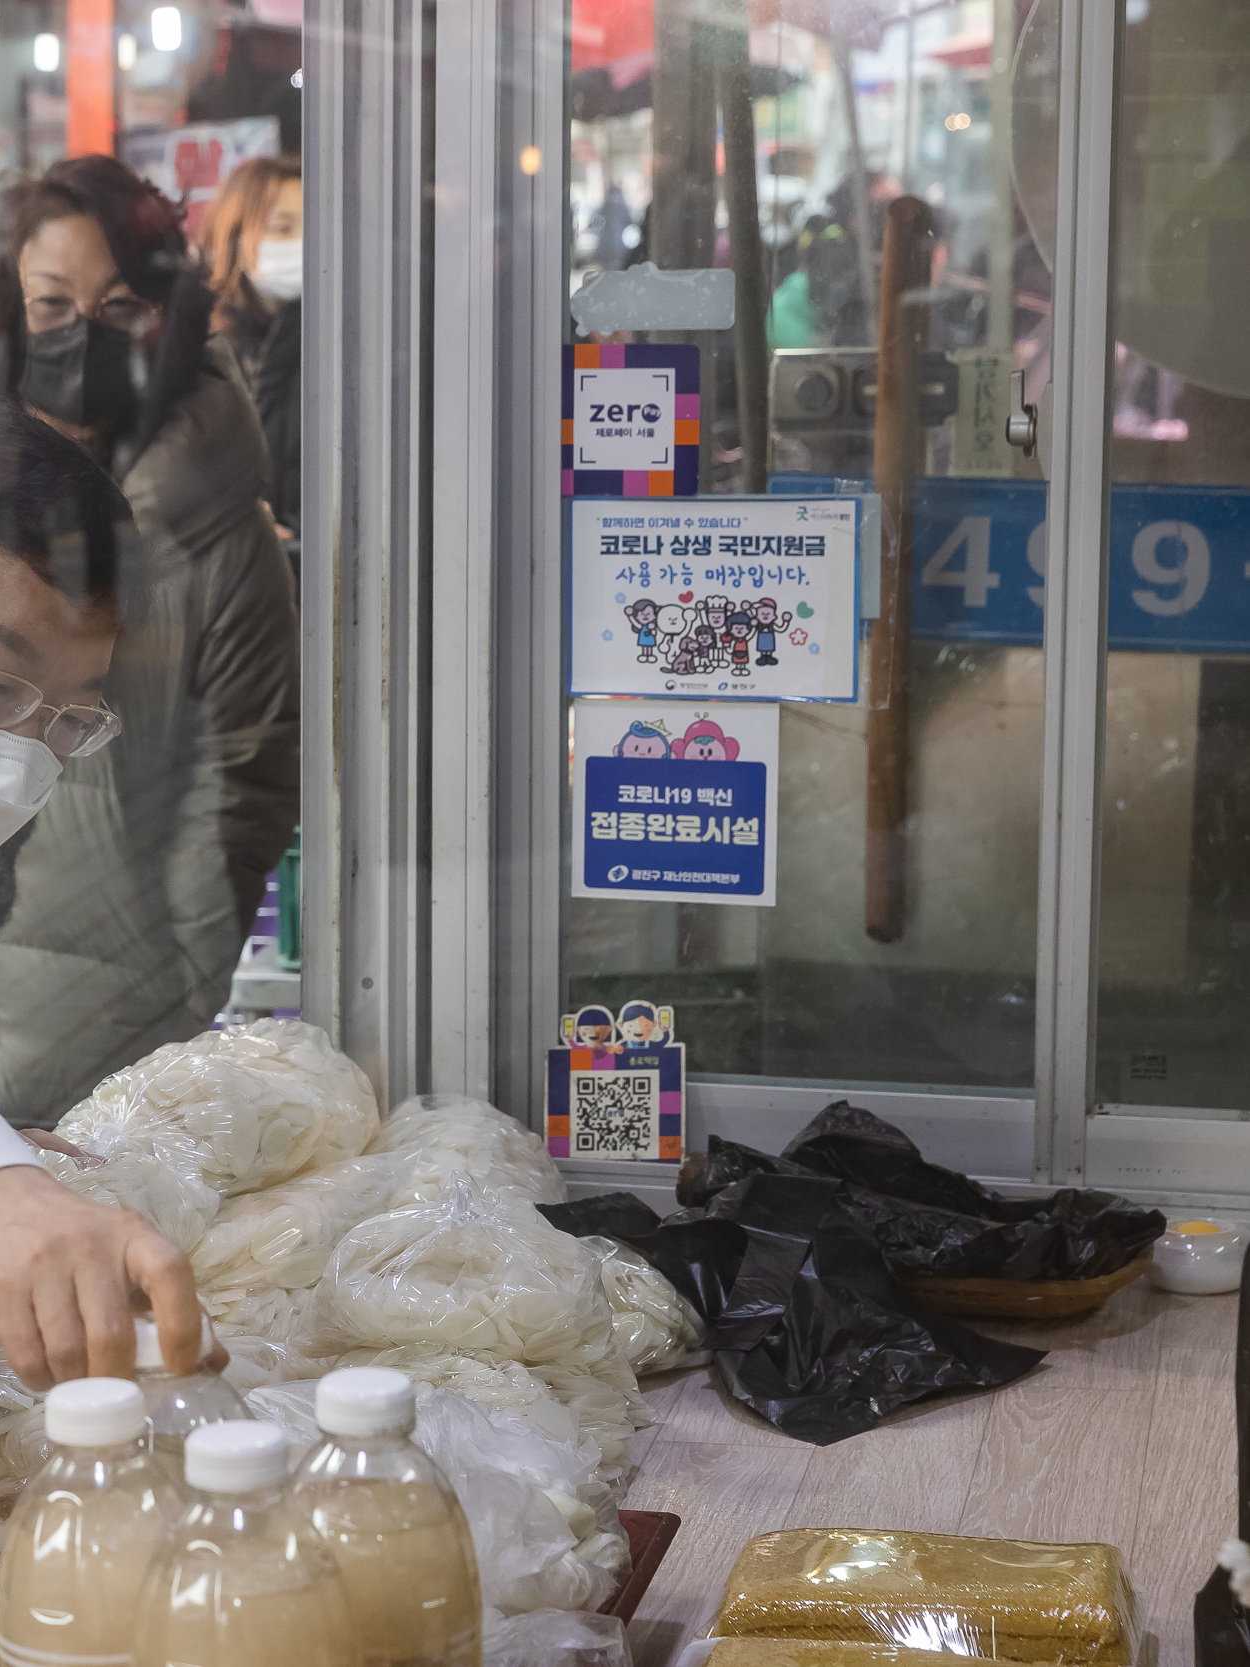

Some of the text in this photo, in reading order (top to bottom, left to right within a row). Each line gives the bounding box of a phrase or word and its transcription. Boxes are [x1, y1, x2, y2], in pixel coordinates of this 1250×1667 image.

[595, 427, 655, 438] 제로페이 서울
[648, 516, 681, 529] 이겨낼
[684, 516, 695, 529] 수
[599, 535, 826, 557] 코로나 상생 국민지원금
[615, 561, 811, 588] 사용 가능 매장입니다.
[618, 784, 733, 807] 코로나19 백신
[590, 811, 759, 846] 접종완료시설
